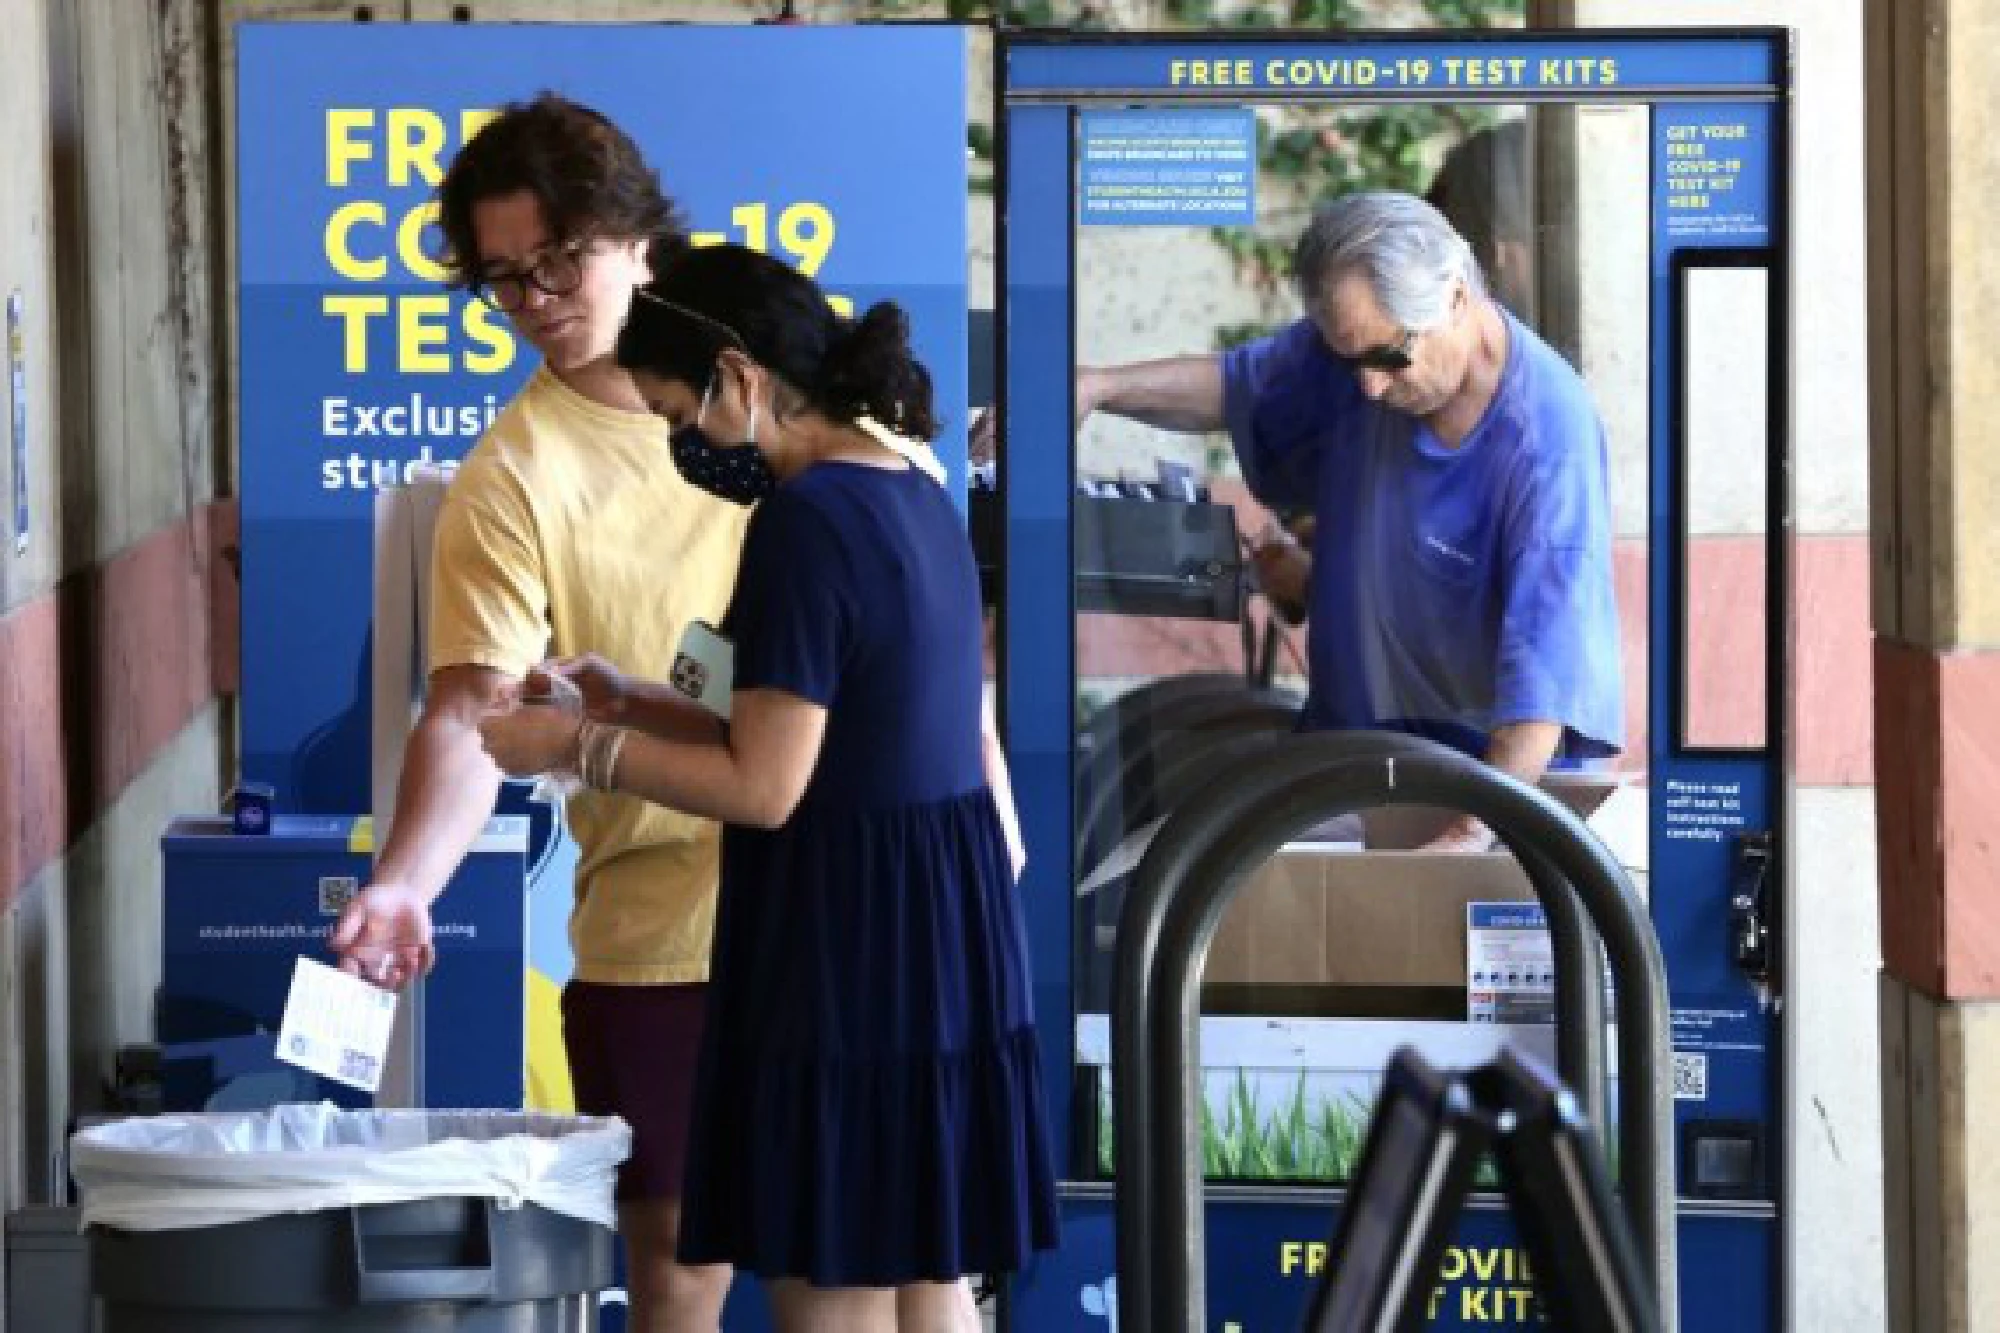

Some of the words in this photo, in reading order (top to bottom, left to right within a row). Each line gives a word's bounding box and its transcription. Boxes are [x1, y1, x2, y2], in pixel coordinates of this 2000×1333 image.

[1170, 59, 1254, 85] FREE
[1266, 59, 1431, 85] COVID-19
[1443, 59, 1527, 85] TEST
[1539, 59, 1619, 85] KITS
[1667, 125, 1698, 140] GET
[1702, 124, 1746, 139] YOUR
[326, 108, 504, 187] FR
[1667, 159, 1743, 174] COVID-19
[1667, 177, 1705, 190] TEST
[323, 296, 516, 373] TES
[323, 393, 505, 436] Exclusi
[1667, 780, 1706, 793] Please
[1709, 781, 1741, 795] read
[1667, 828, 1723, 842] carefully
[1281, 1241, 1328, 1277] FR
